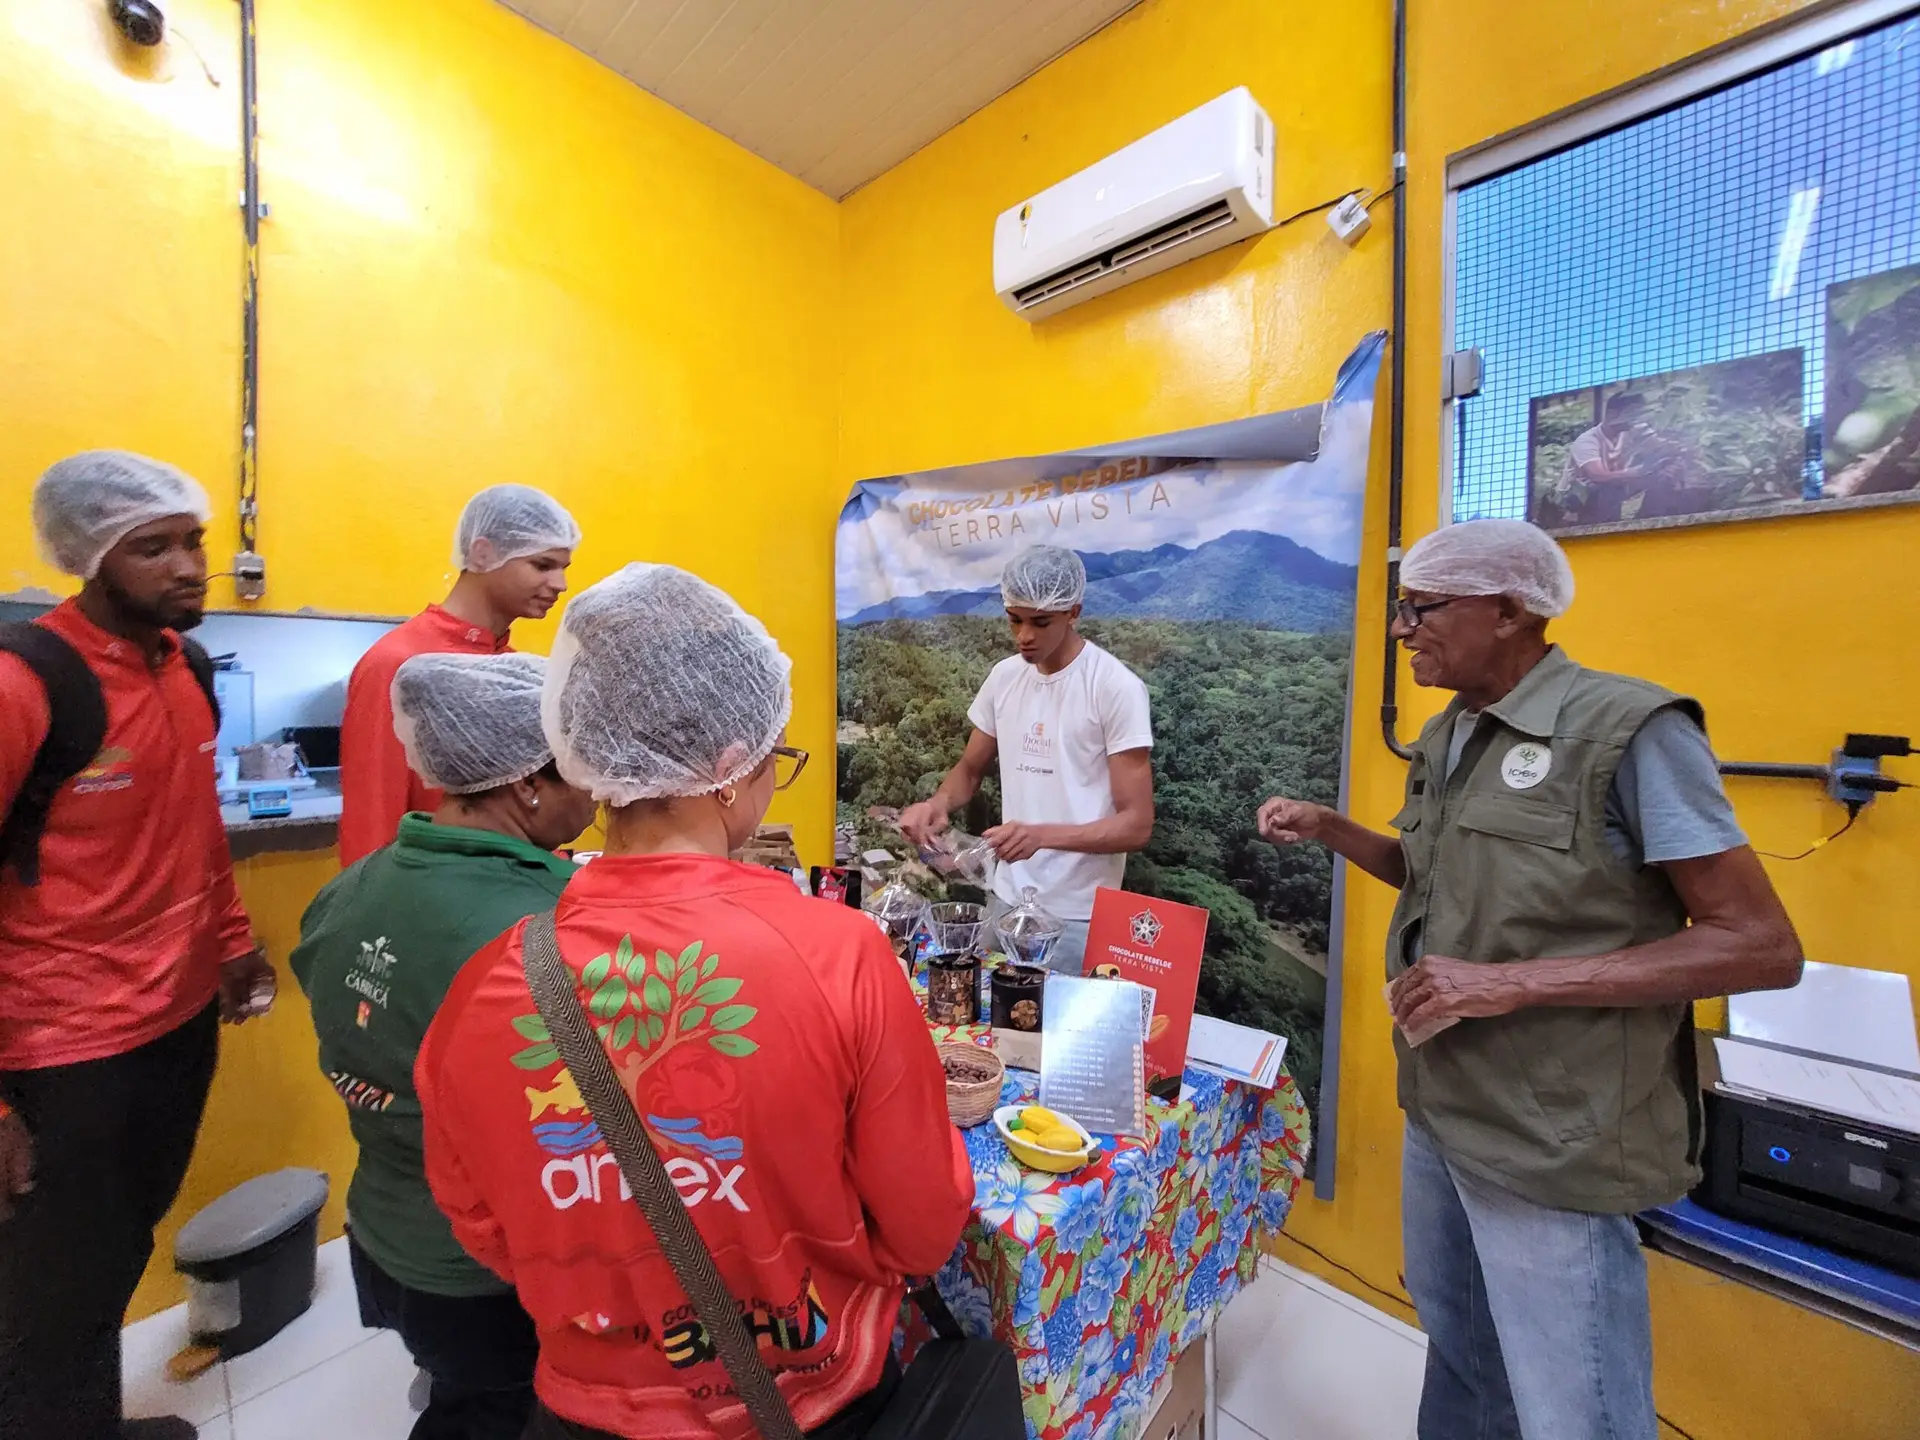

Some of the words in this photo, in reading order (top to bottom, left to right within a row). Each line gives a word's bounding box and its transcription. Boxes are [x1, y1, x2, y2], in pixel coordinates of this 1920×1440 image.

[908, 480, 1053, 526] CHOCOLATE
[931, 512, 1026, 549] TERRA
[1047, 480, 1172, 528] VISTA
[1108, 945, 1144, 961] CHOCOLATE
[1144, 955, 1173, 970] REBELDE
[1113, 954, 1137, 967] TERRA
[1140, 962, 1164, 975] VISTA
[1844, 1131, 1888, 1149] EPSON
